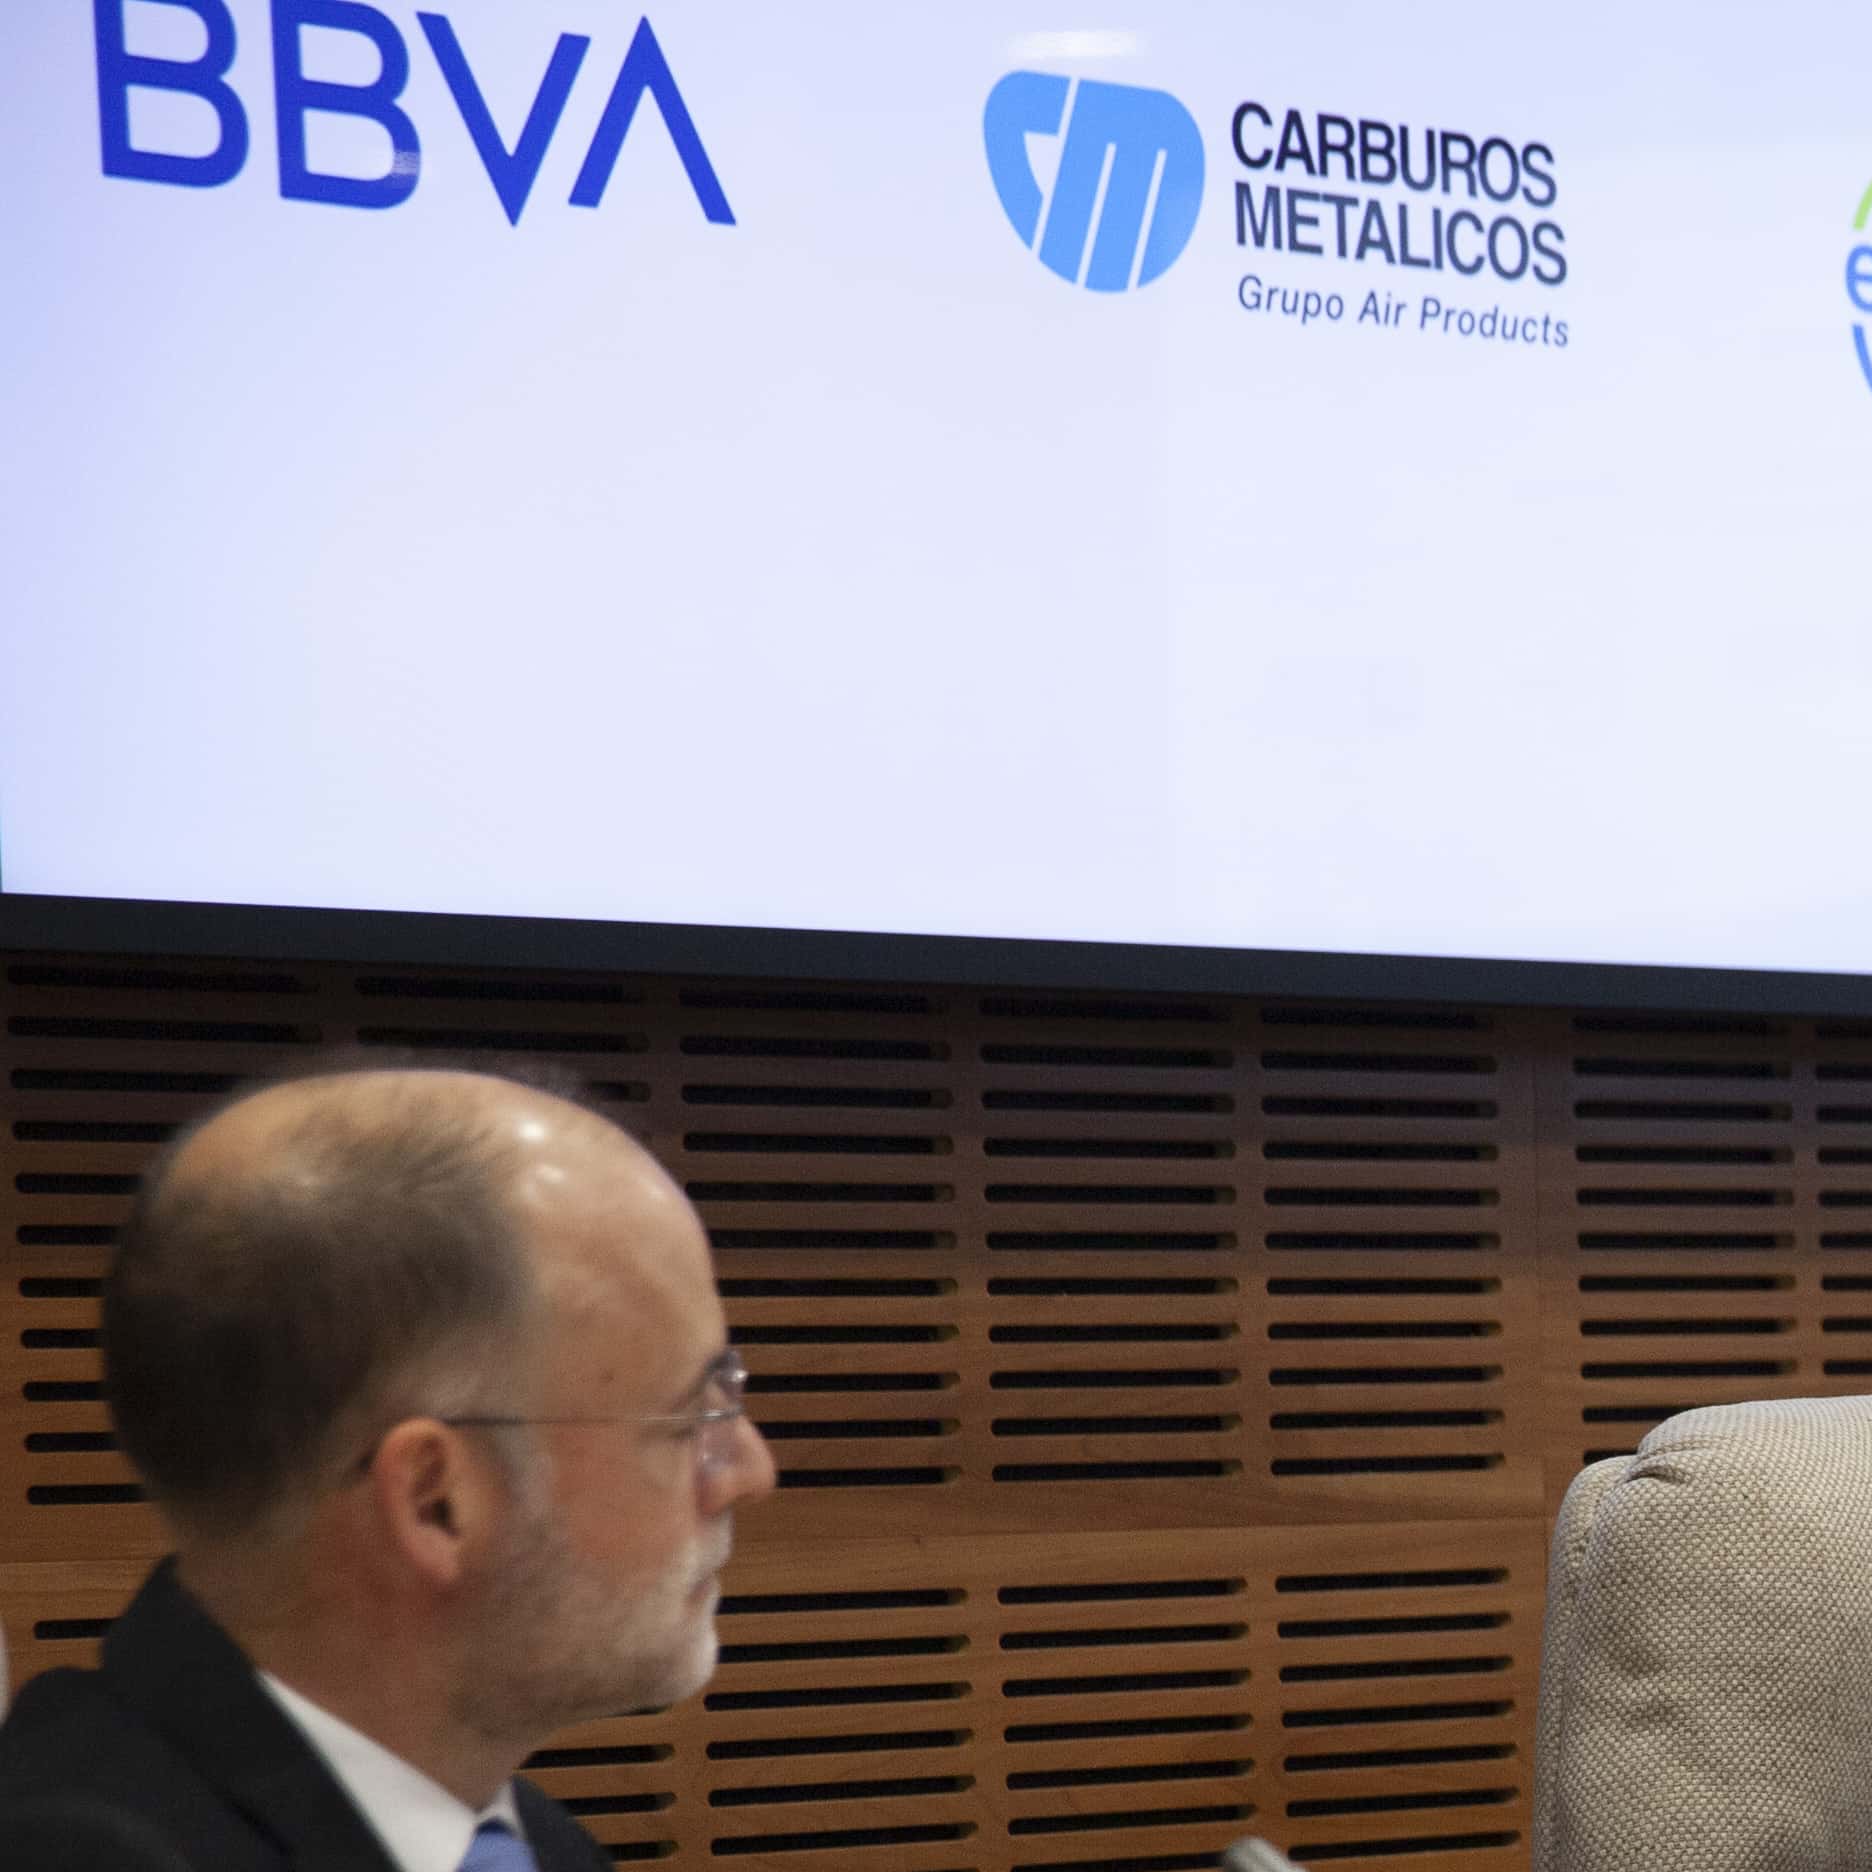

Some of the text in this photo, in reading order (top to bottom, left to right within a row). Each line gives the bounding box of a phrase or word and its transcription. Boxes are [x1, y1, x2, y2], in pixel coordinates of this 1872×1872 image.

[94, 0, 737, 228] BBVA
[1231, 101, 1557, 208] CARBUROS
[1235, 181, 1568, 286] METALICOS
[1238, 275, 1569, 347] Grupo Air Products
